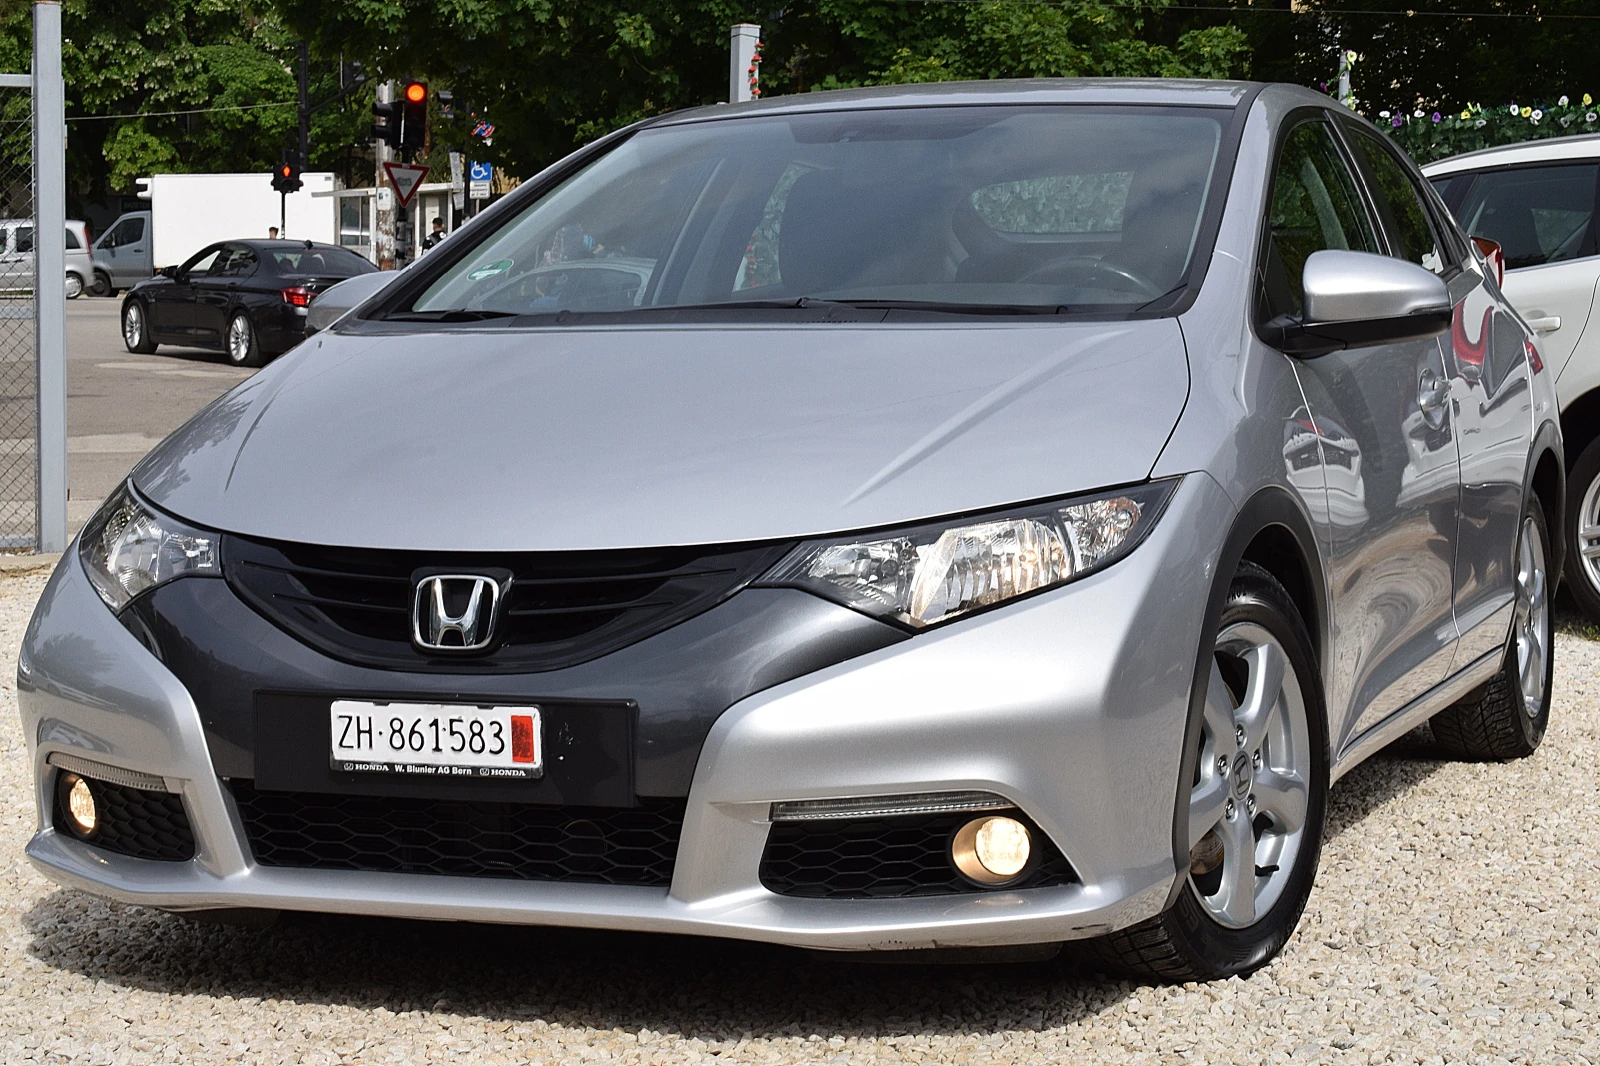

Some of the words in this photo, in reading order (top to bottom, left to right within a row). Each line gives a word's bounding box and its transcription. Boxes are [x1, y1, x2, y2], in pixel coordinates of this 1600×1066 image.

[355, 763, 389, 771] HONDA
[394, 764, 405, 772] W.
[437, 767, 450, 775] AG
[452, 767, 472, 776] Bern
[490, 769, 526, 777] HONDA
